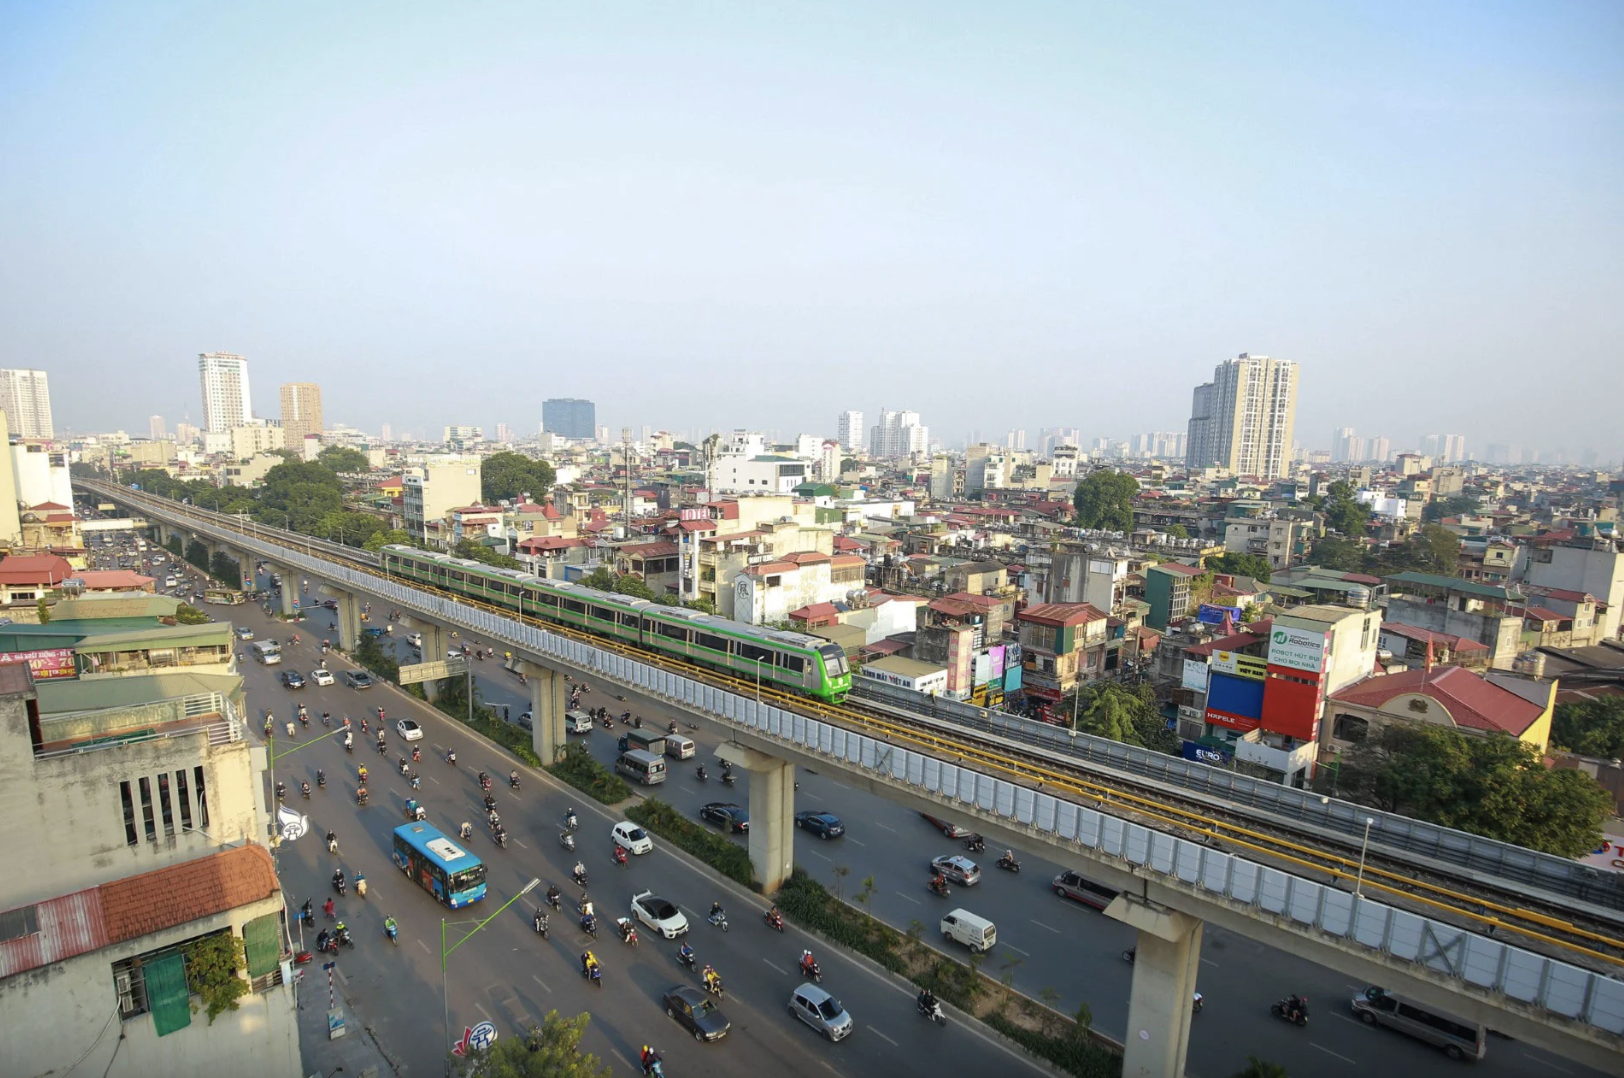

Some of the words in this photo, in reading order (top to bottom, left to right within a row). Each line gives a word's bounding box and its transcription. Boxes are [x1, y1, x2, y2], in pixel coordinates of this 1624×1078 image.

[680, 508, 710, 520] HOTEL
[1288, 638, 1322, 649] Robotics
[1271, 648, 1294, 656] ROBOT
[1273, 656, 1288, 664] CHO
[902, 679, 911, 688] AN
[1195, 748, 1220, 761] EURO
